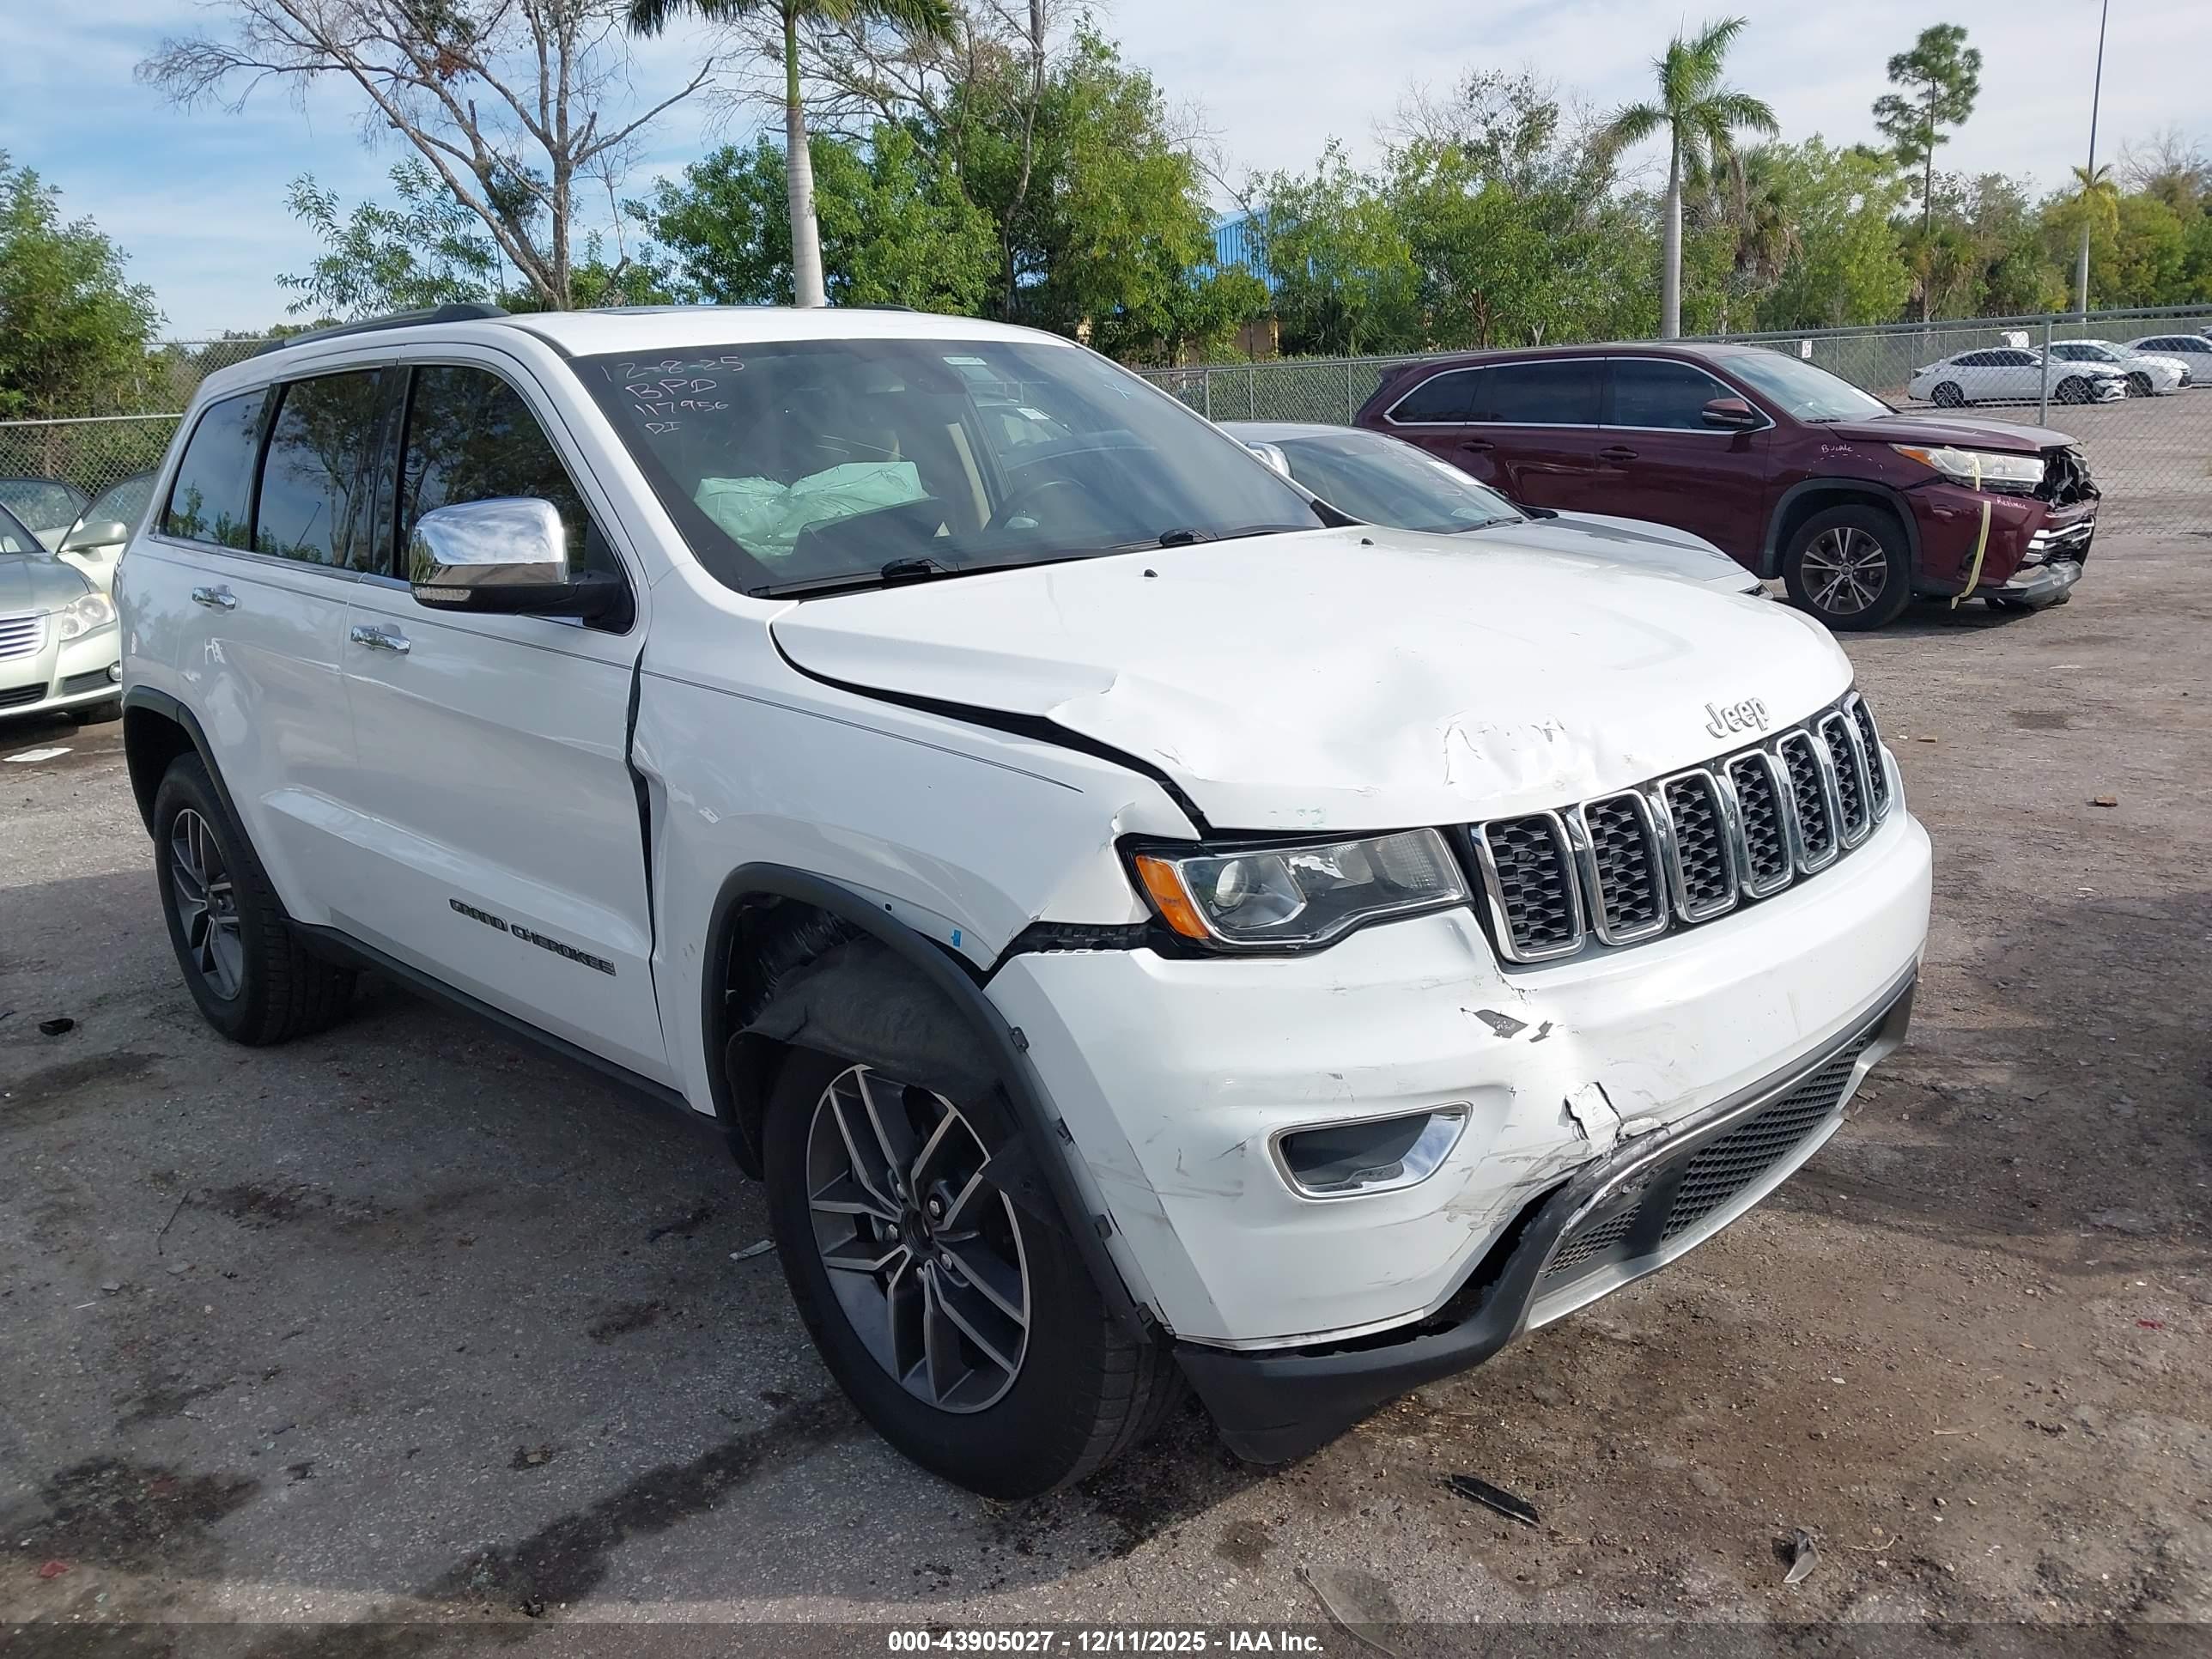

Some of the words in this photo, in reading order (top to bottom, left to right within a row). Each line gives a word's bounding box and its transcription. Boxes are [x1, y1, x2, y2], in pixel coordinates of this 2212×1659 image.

[601, 356, 745, 382] 12-8-25
[625, 379, 717, 399] BPD
[635, 399, 729, 416] 117956
[1705, 697, 1770, 739] Jeep
[448, 897, 509, 933] GRAND
[510, 923, 617, 977] CHEROKEE
